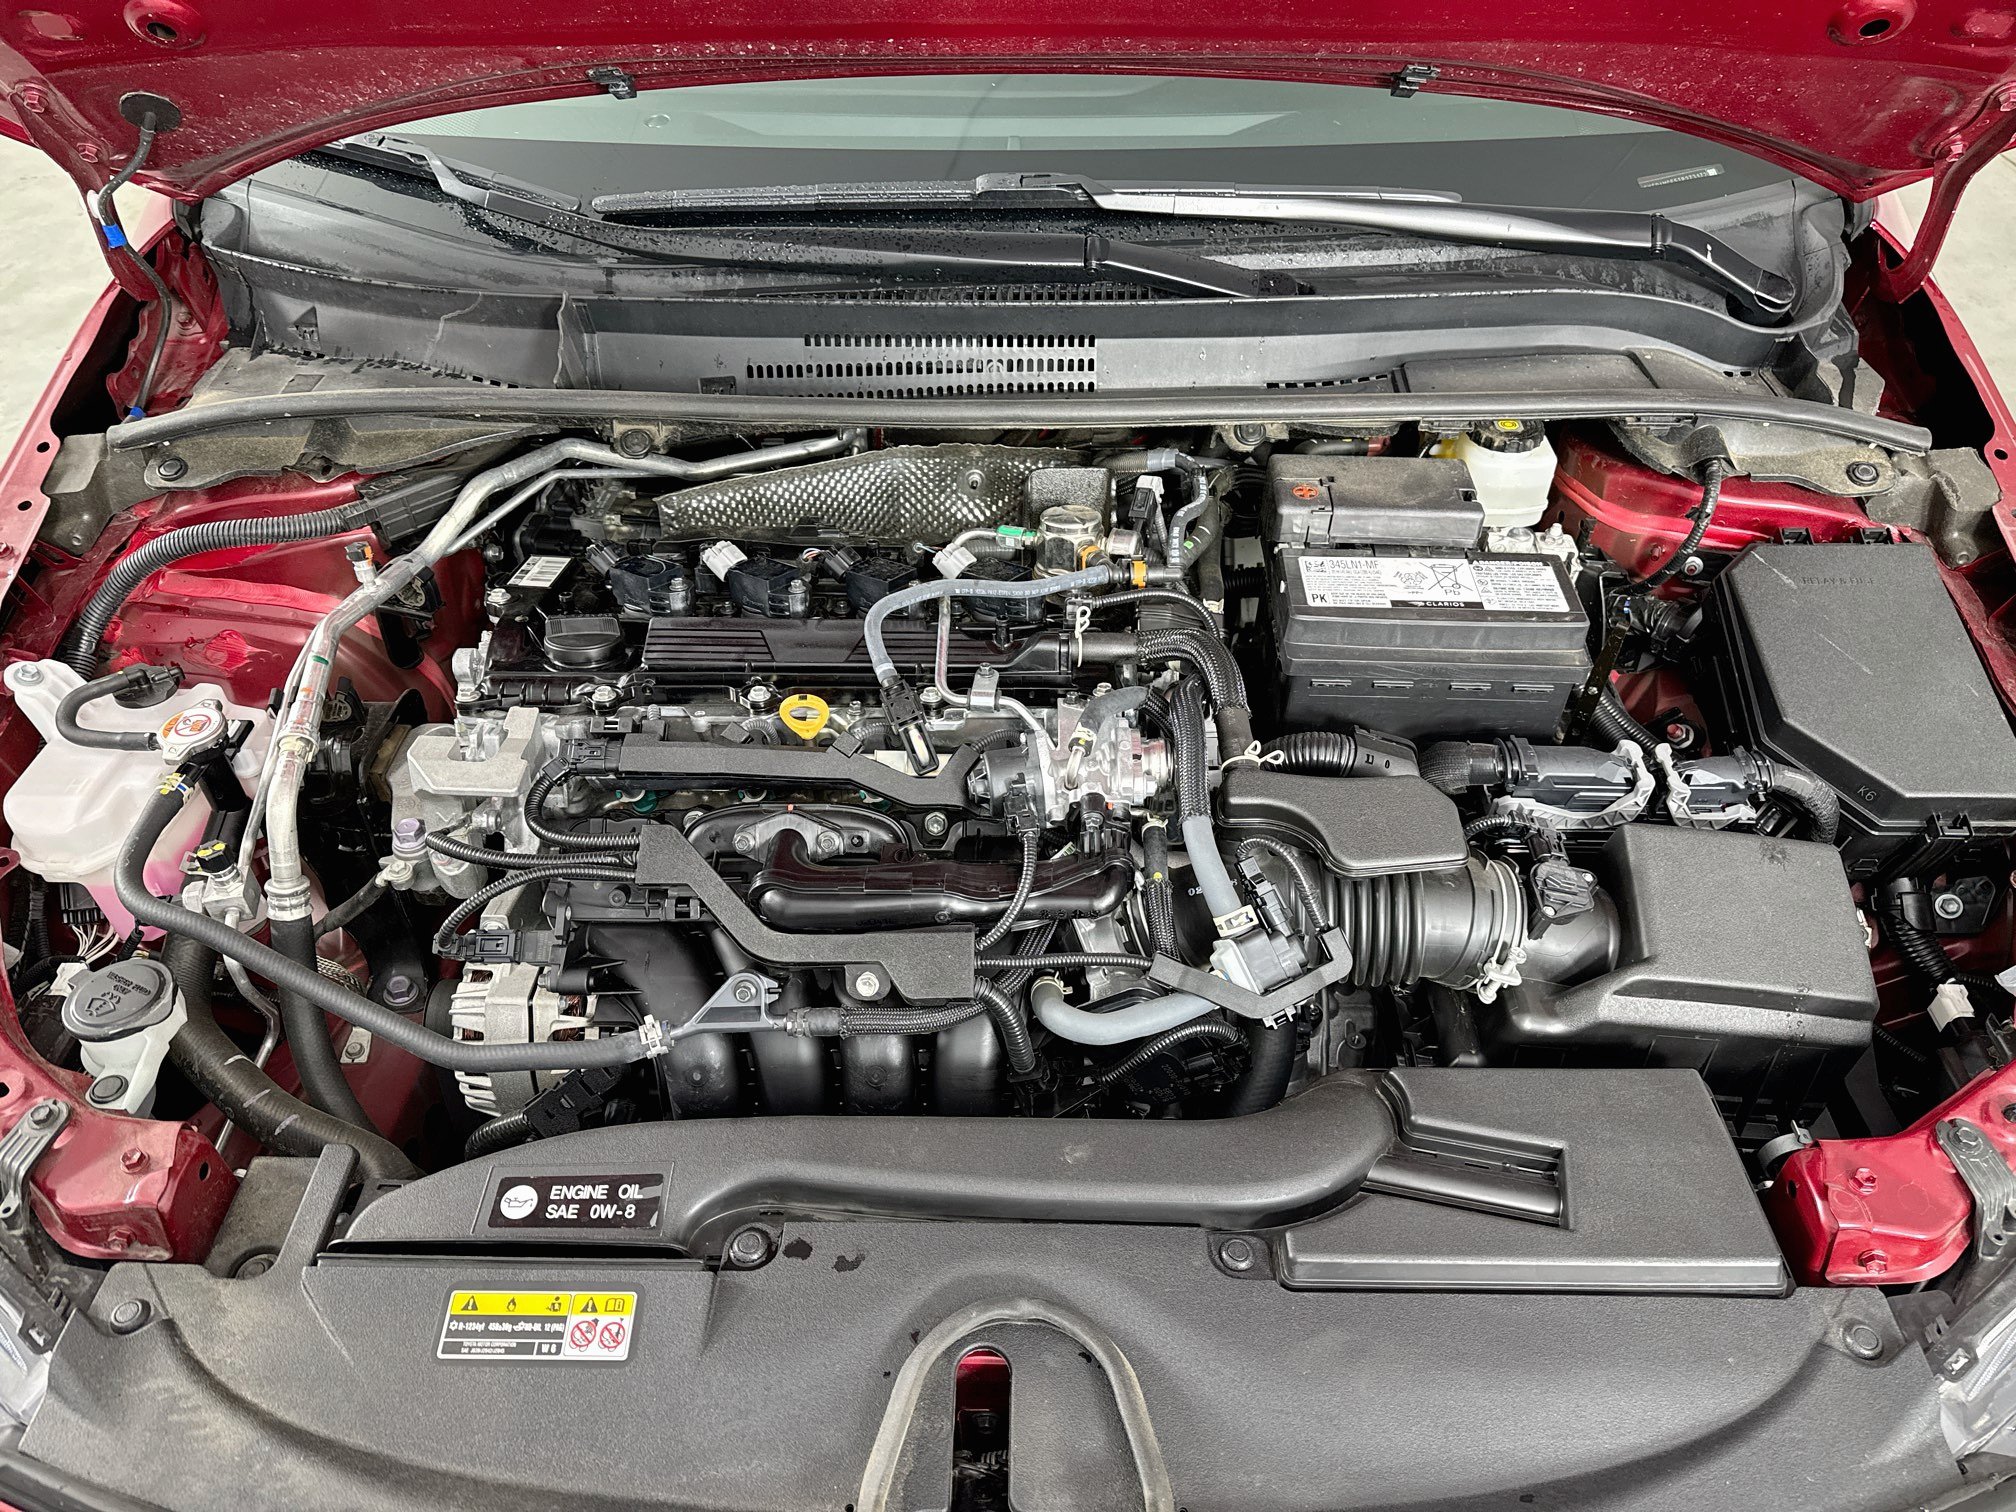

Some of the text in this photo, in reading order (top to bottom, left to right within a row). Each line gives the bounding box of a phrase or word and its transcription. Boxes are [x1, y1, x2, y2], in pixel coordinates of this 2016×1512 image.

[1311, 593, 1328, 603] PK
[1857, 785, 1877, 801] K6
[550, 1184, 643, 1199] ENGINE OIL
[545, 1204, 636, 1219] SAE 0W-8
